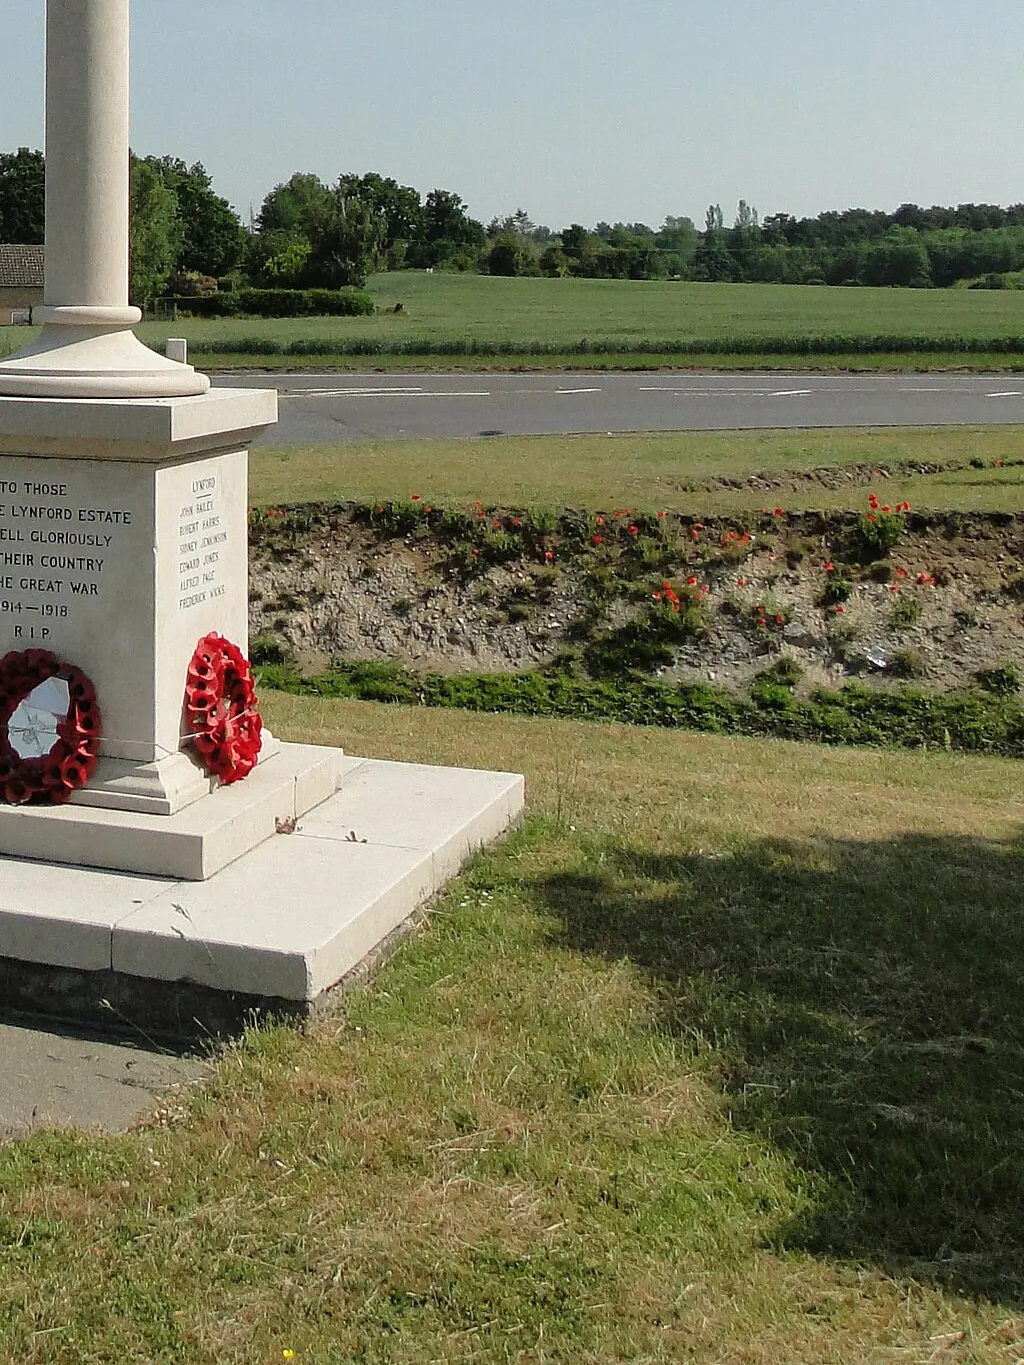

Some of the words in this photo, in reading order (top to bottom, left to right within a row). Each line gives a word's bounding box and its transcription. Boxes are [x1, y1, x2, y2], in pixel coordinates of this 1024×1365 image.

[0, 481, 17, 493] TO
[24, 483, 67, 496] THOSE
[11, 506, 72, 520] LYNFORD
[78, 509, 132, 524] ESTATE
[30, 530, 112, 547] GLORIOUSLY
[41, 556, 103, 571] COUNTRY
[20, 578, 63, 593] GREAT
[70, 582, 98, 595] WAR
